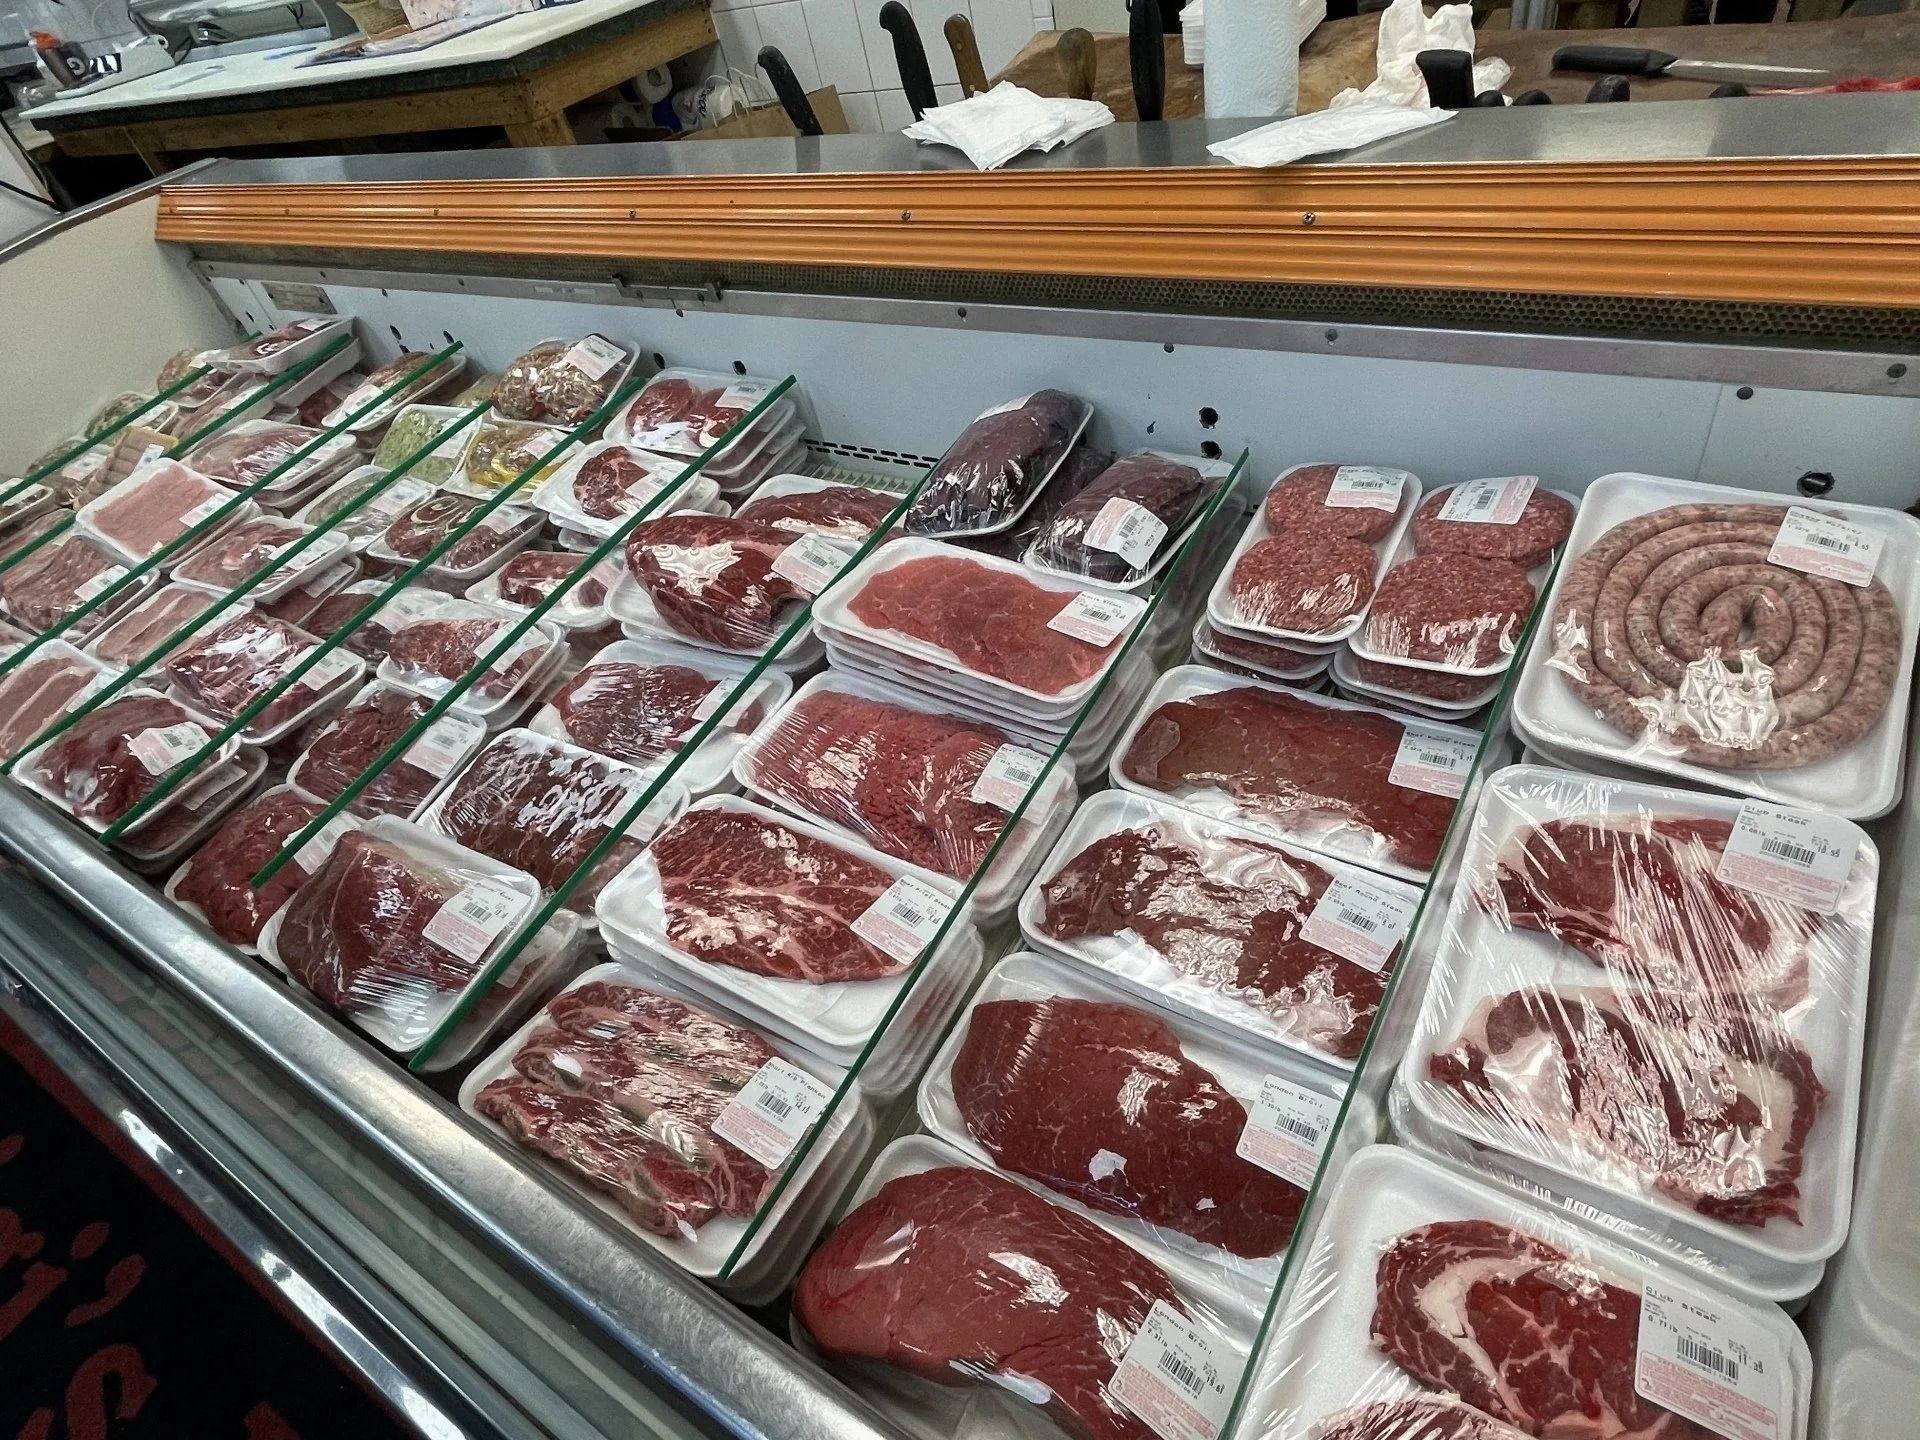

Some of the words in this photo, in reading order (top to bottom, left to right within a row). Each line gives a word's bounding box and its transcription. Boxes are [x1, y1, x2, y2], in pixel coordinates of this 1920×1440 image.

[1744, 804, 1770, 816] Club
[1776, 813, 1807, 826] Steak
[1264, 1081, 1294, 1096] London
[1298, 1095, 1323, 1109] Broil
[1645, 1285, 1674, 1303] Club
[1682, 1302, 1717, 1324] Steak
[1154, 1306, 1184, 1332] London
[1188, 1333, 1212, 1355] Broil
